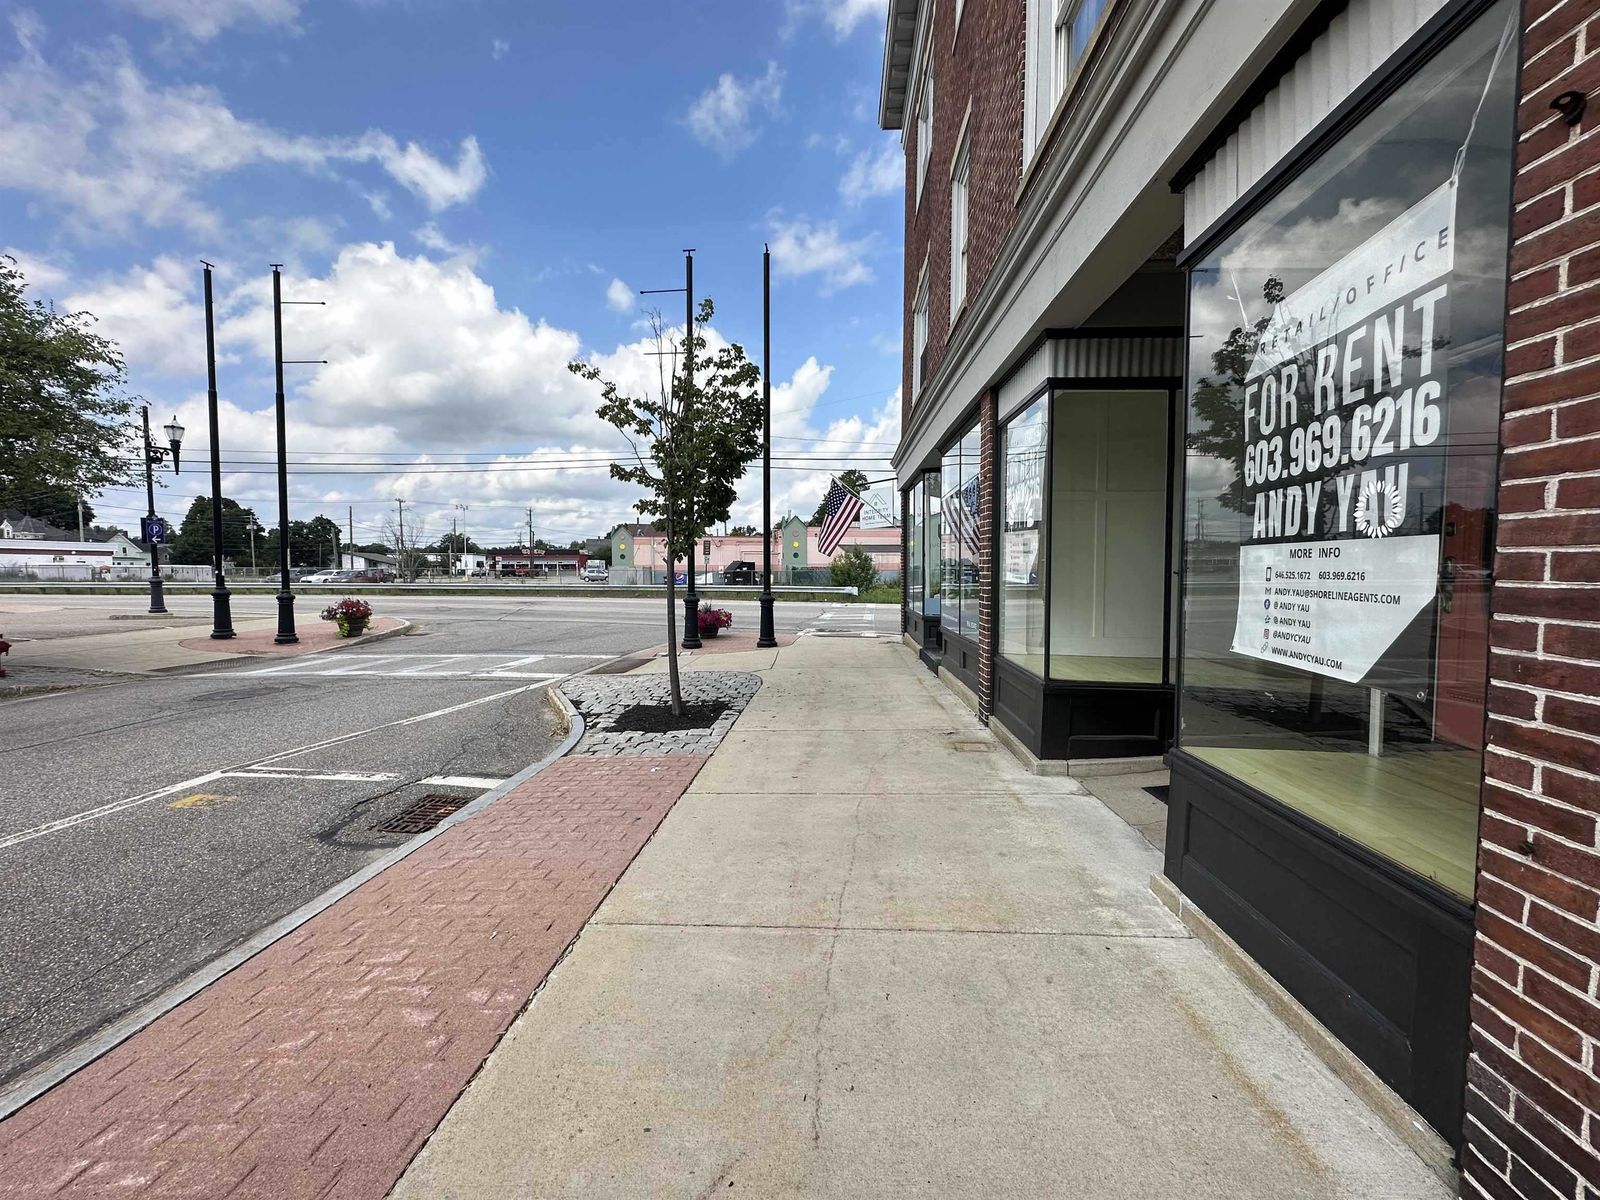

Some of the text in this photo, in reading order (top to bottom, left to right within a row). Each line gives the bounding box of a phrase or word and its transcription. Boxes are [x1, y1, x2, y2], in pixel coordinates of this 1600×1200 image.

[1260, 226, 1449, 354] RETAIL/OFFICE
[1244, 284, 1448, 442] FOR RENT
[1244, 381, 1441, 487] 603.969.6216
[1253, 463, 1408, 539] ANDY YAU
[153, 526, 159, 534] P
[1290, 547, 1341, 559] MORE INFO
[1275, 571, 1366, 581] 646.525.1672 603.969.6216
[1274, 587, 1401, 605] ANDY.YAU@SHORELINEAGENTS.COM
[1297, 603, 1310, 612] YAU
[1297, 619, 1311, 628] YAU
[1272, 630, 1311, 644] @ANDYCYAU
[1271, 646, 1342, 670] WWW.ANDYCYAU.COM
